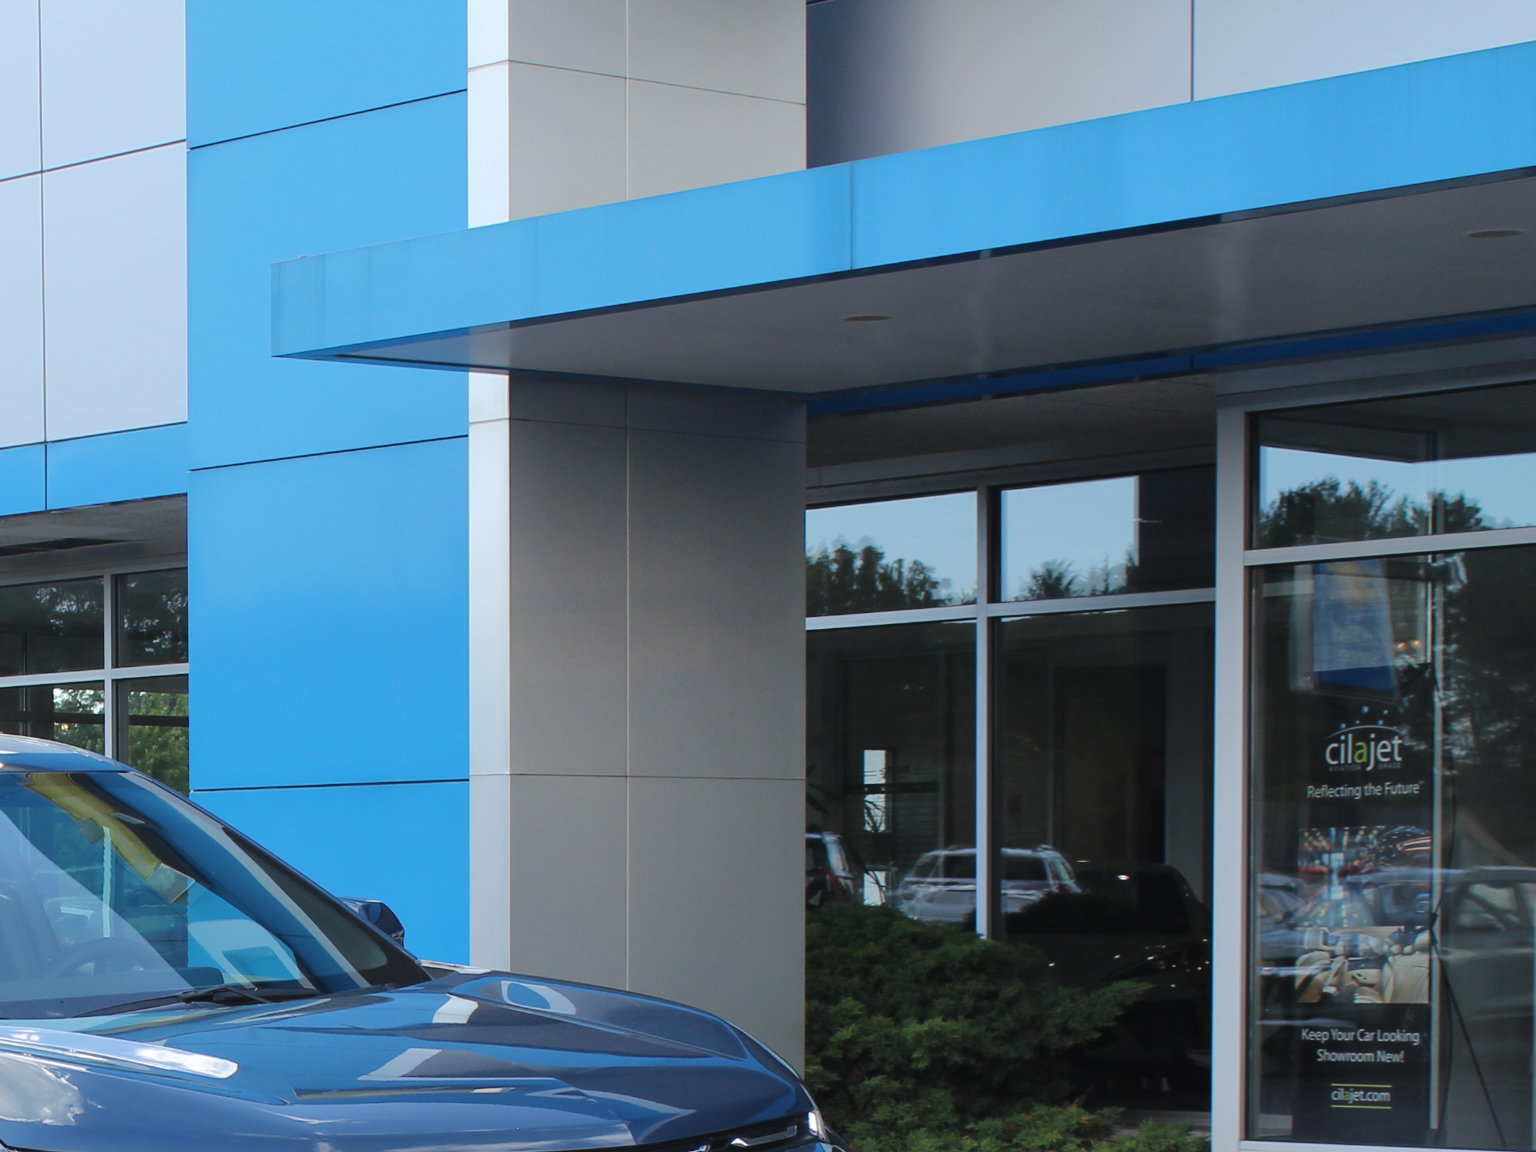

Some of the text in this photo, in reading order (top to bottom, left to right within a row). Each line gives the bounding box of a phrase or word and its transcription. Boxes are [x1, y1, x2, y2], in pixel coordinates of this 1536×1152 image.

[1325, 733, 1403, 772] cilajet
[1307, 782, 1420, 800] Reflecting the Future
[1301, 1028, 1420, 1046] Keep Your Car Looking
[1317, 1049, 1404, 1063] Showroom New!
[1331, 1088, 1391, 1104] cilajet.com
